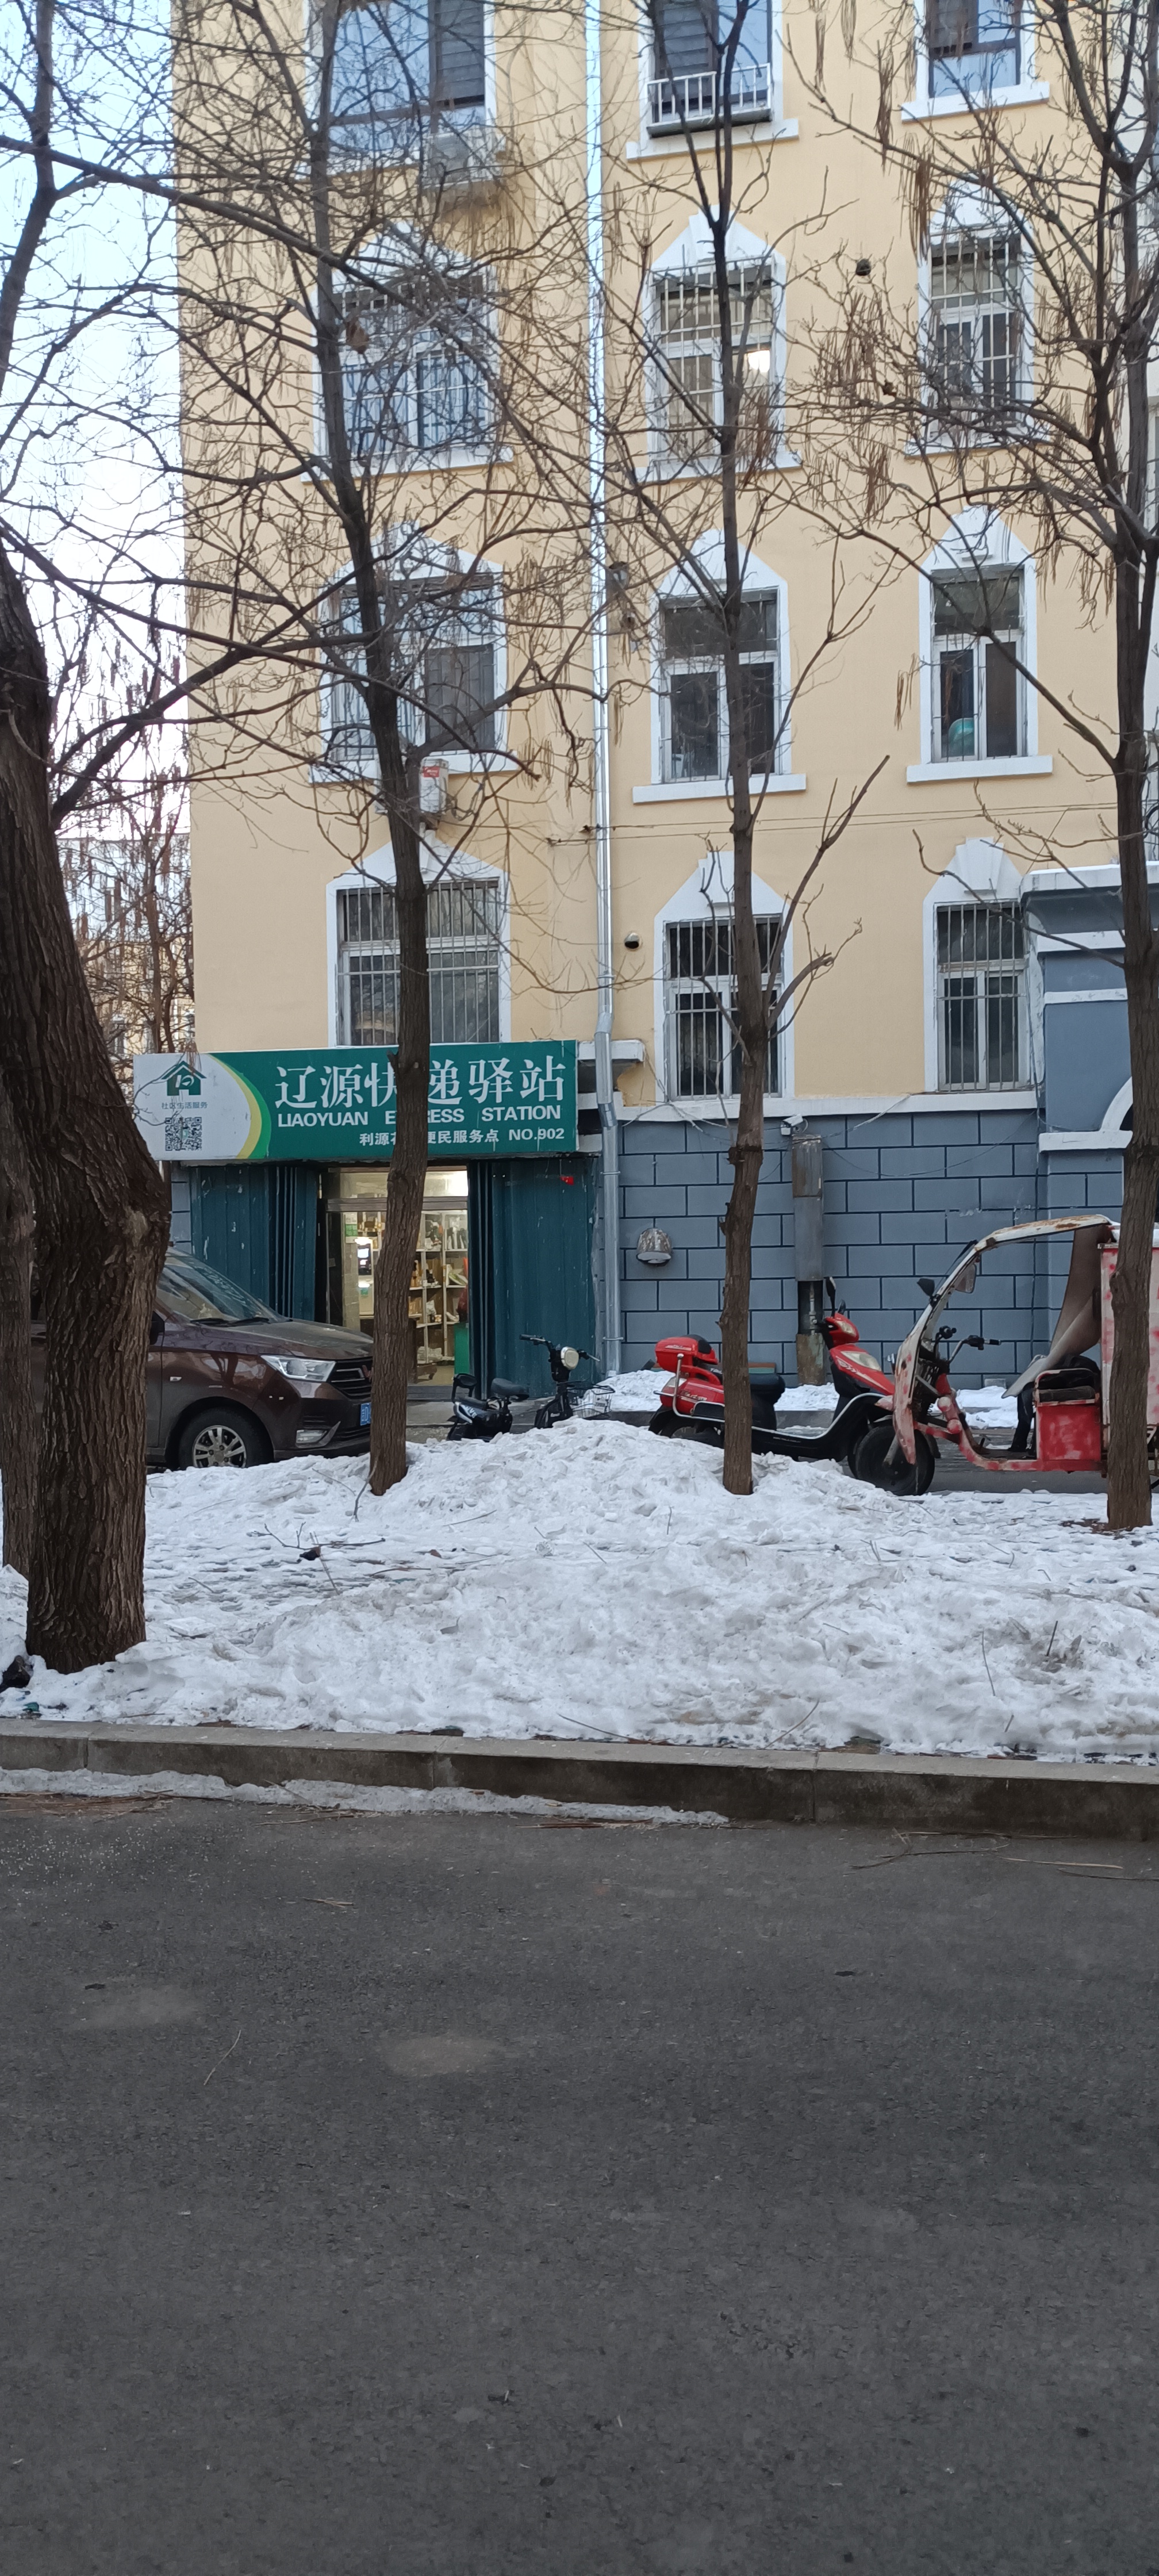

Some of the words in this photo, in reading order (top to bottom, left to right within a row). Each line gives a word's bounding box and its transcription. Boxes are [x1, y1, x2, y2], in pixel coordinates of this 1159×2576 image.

[275, 1055, 566, 1109] 辽源快递驿站
[278, 1111, 369, 1127] LIAOYUAN
[481, 1105, 561, 1121] STATION
[509, 1128, 565, 1141] NO.902
